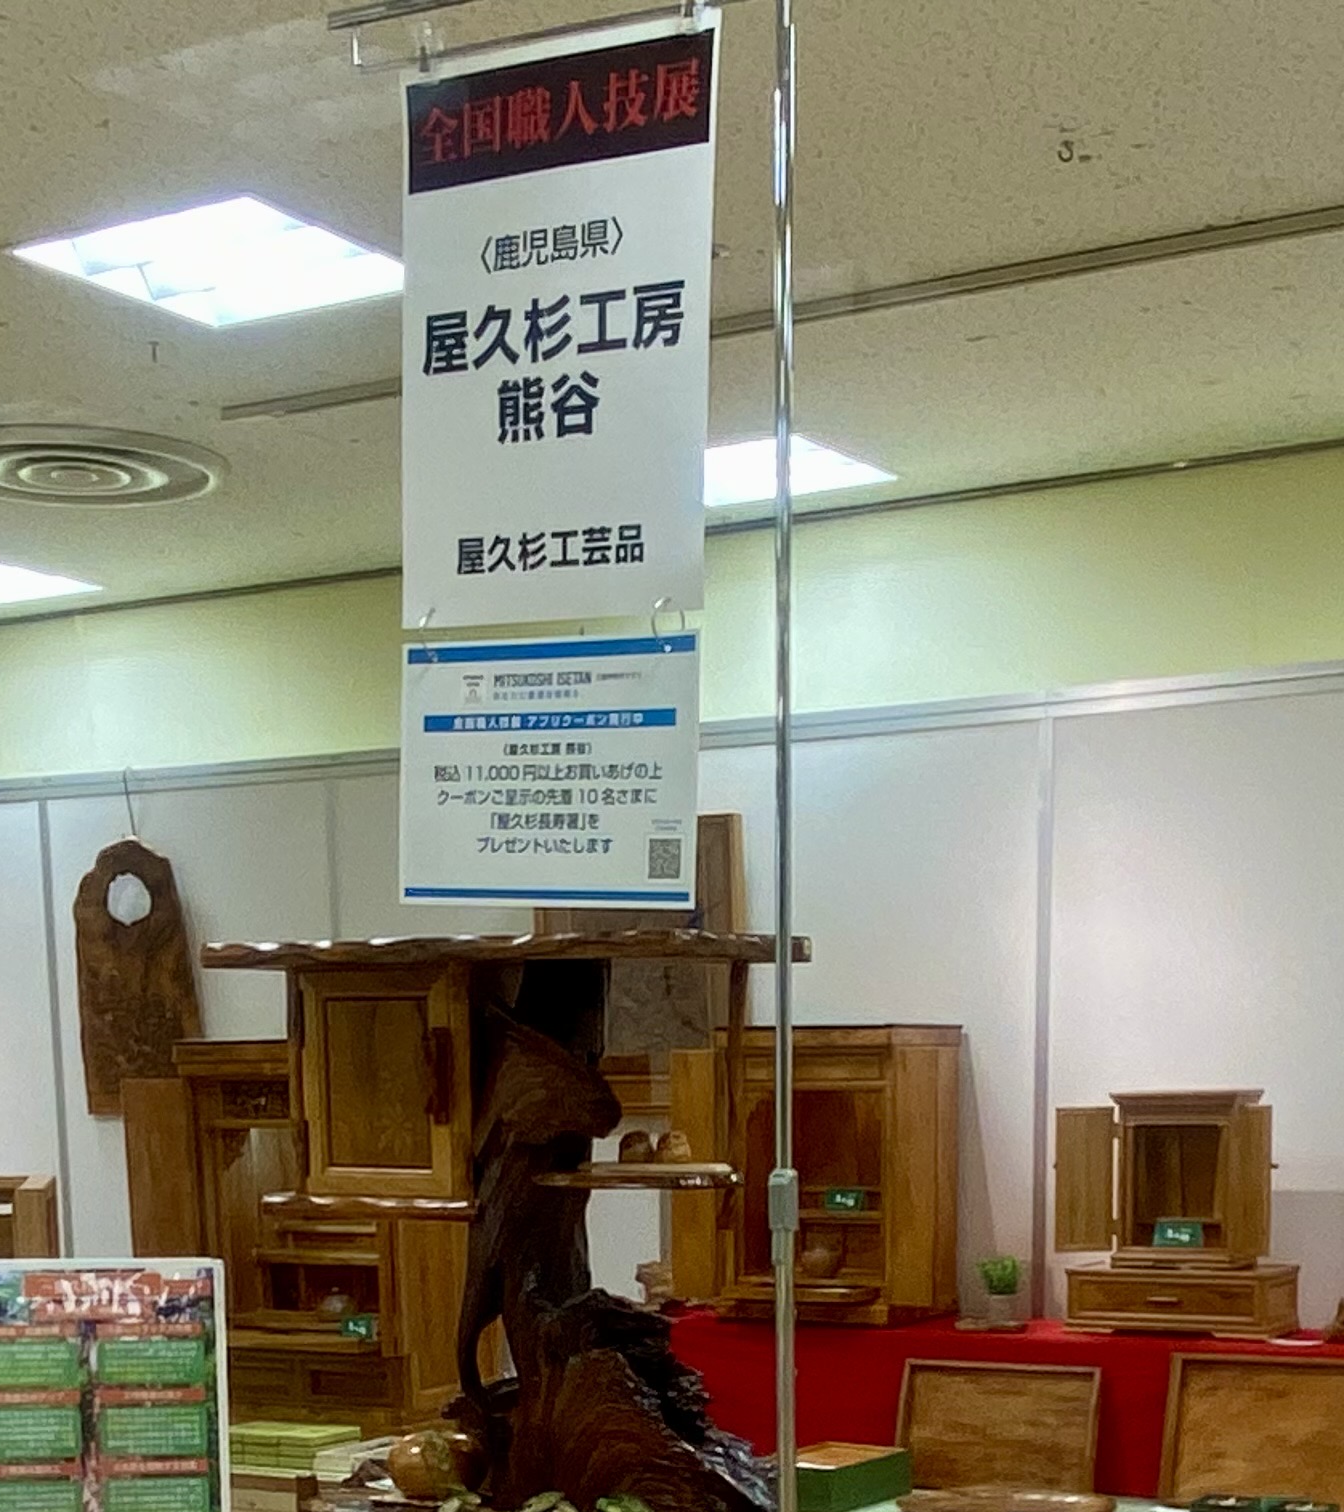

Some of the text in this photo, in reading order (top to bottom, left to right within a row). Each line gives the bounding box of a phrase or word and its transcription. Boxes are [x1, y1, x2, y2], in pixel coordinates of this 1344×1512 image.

[419, 57, 702, 165] 全国職人技展
[422, 279, 686, 376] 屋久杉工房
[496, 370, 601, 444] 熊谷
[456, 523, 646, 575] 屋久杉工芸品
[493, 672, 553, 688] MITSUKOSHI
[556, 671, 592, 685] ISETAN
[476, 836, 614, 855] プレゼントいたします
